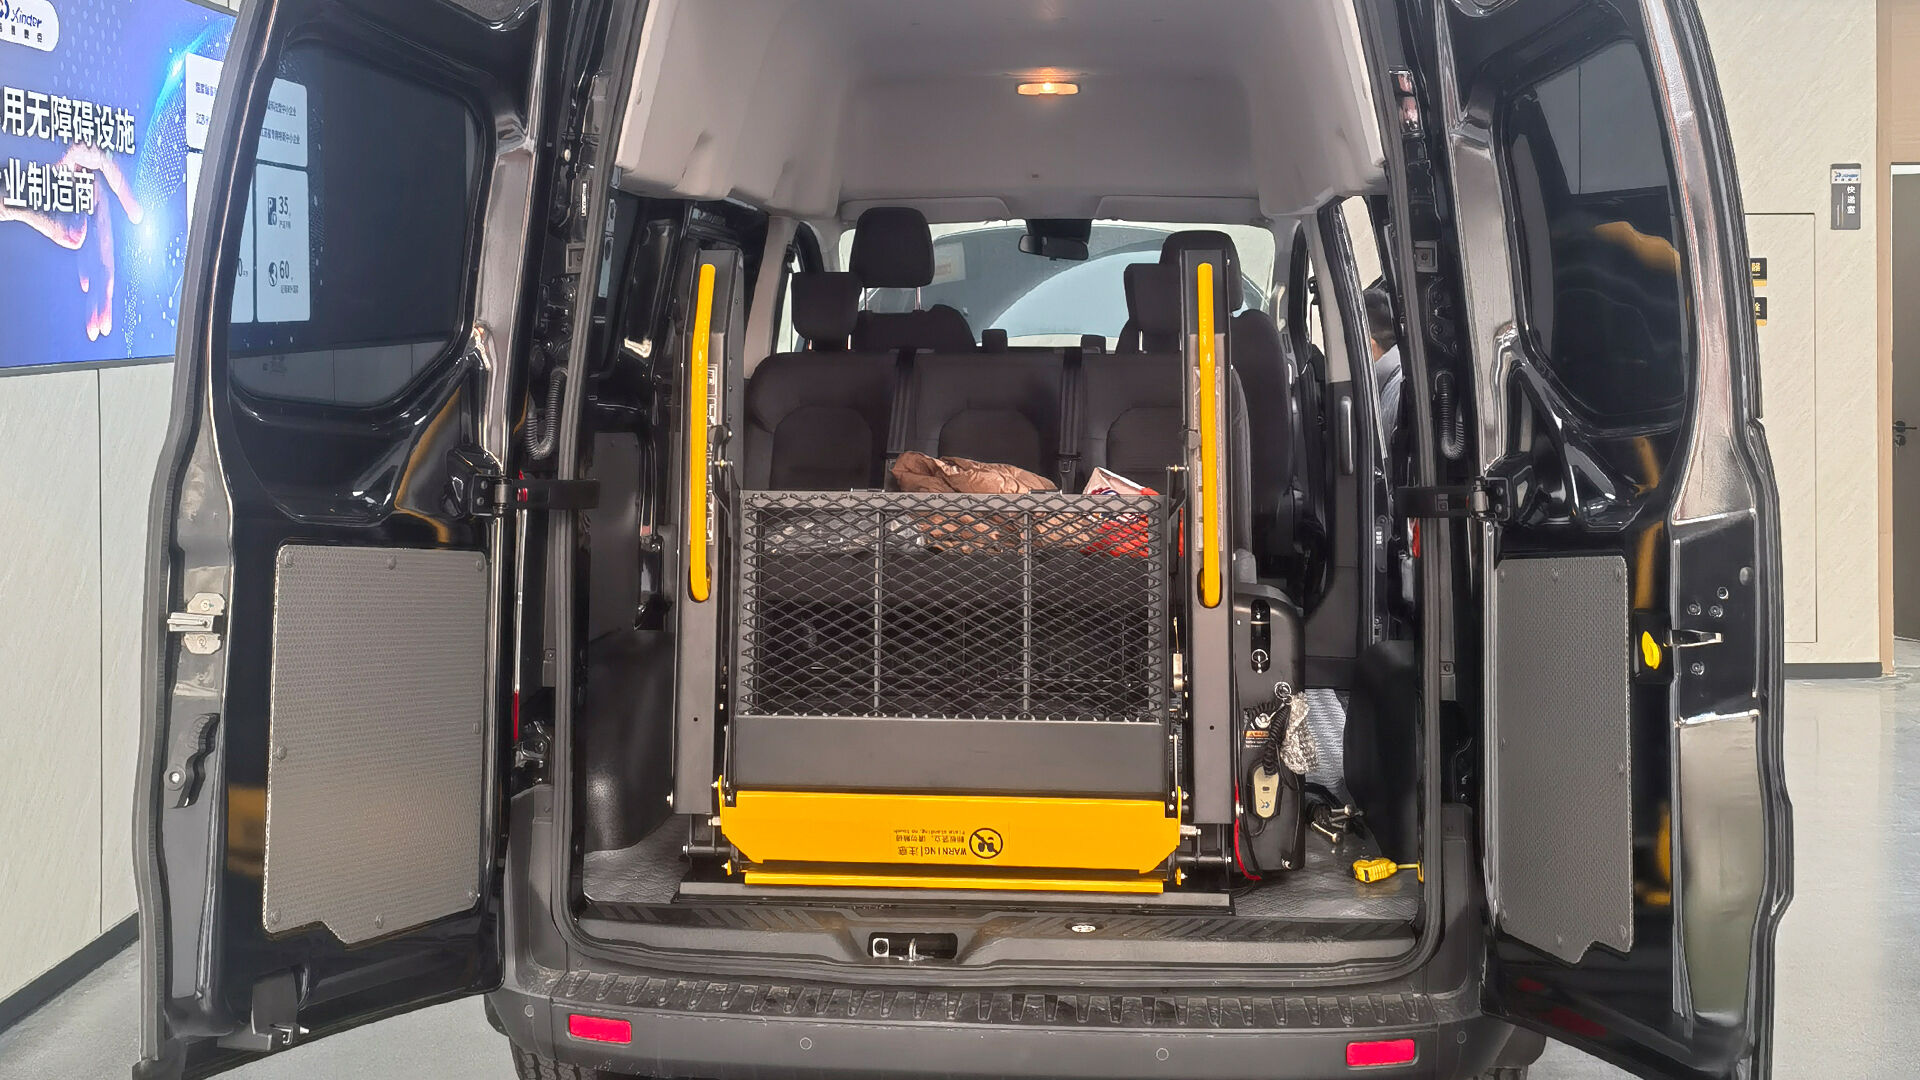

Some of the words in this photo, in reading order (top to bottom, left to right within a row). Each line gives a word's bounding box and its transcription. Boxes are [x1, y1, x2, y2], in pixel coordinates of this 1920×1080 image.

[2, 86, 136, 155] 用无障碍设施
[0, 158, 95, 215] 业制造商
[278, 196, 289, 215] 35
[279, 260, 290, 280] 60
